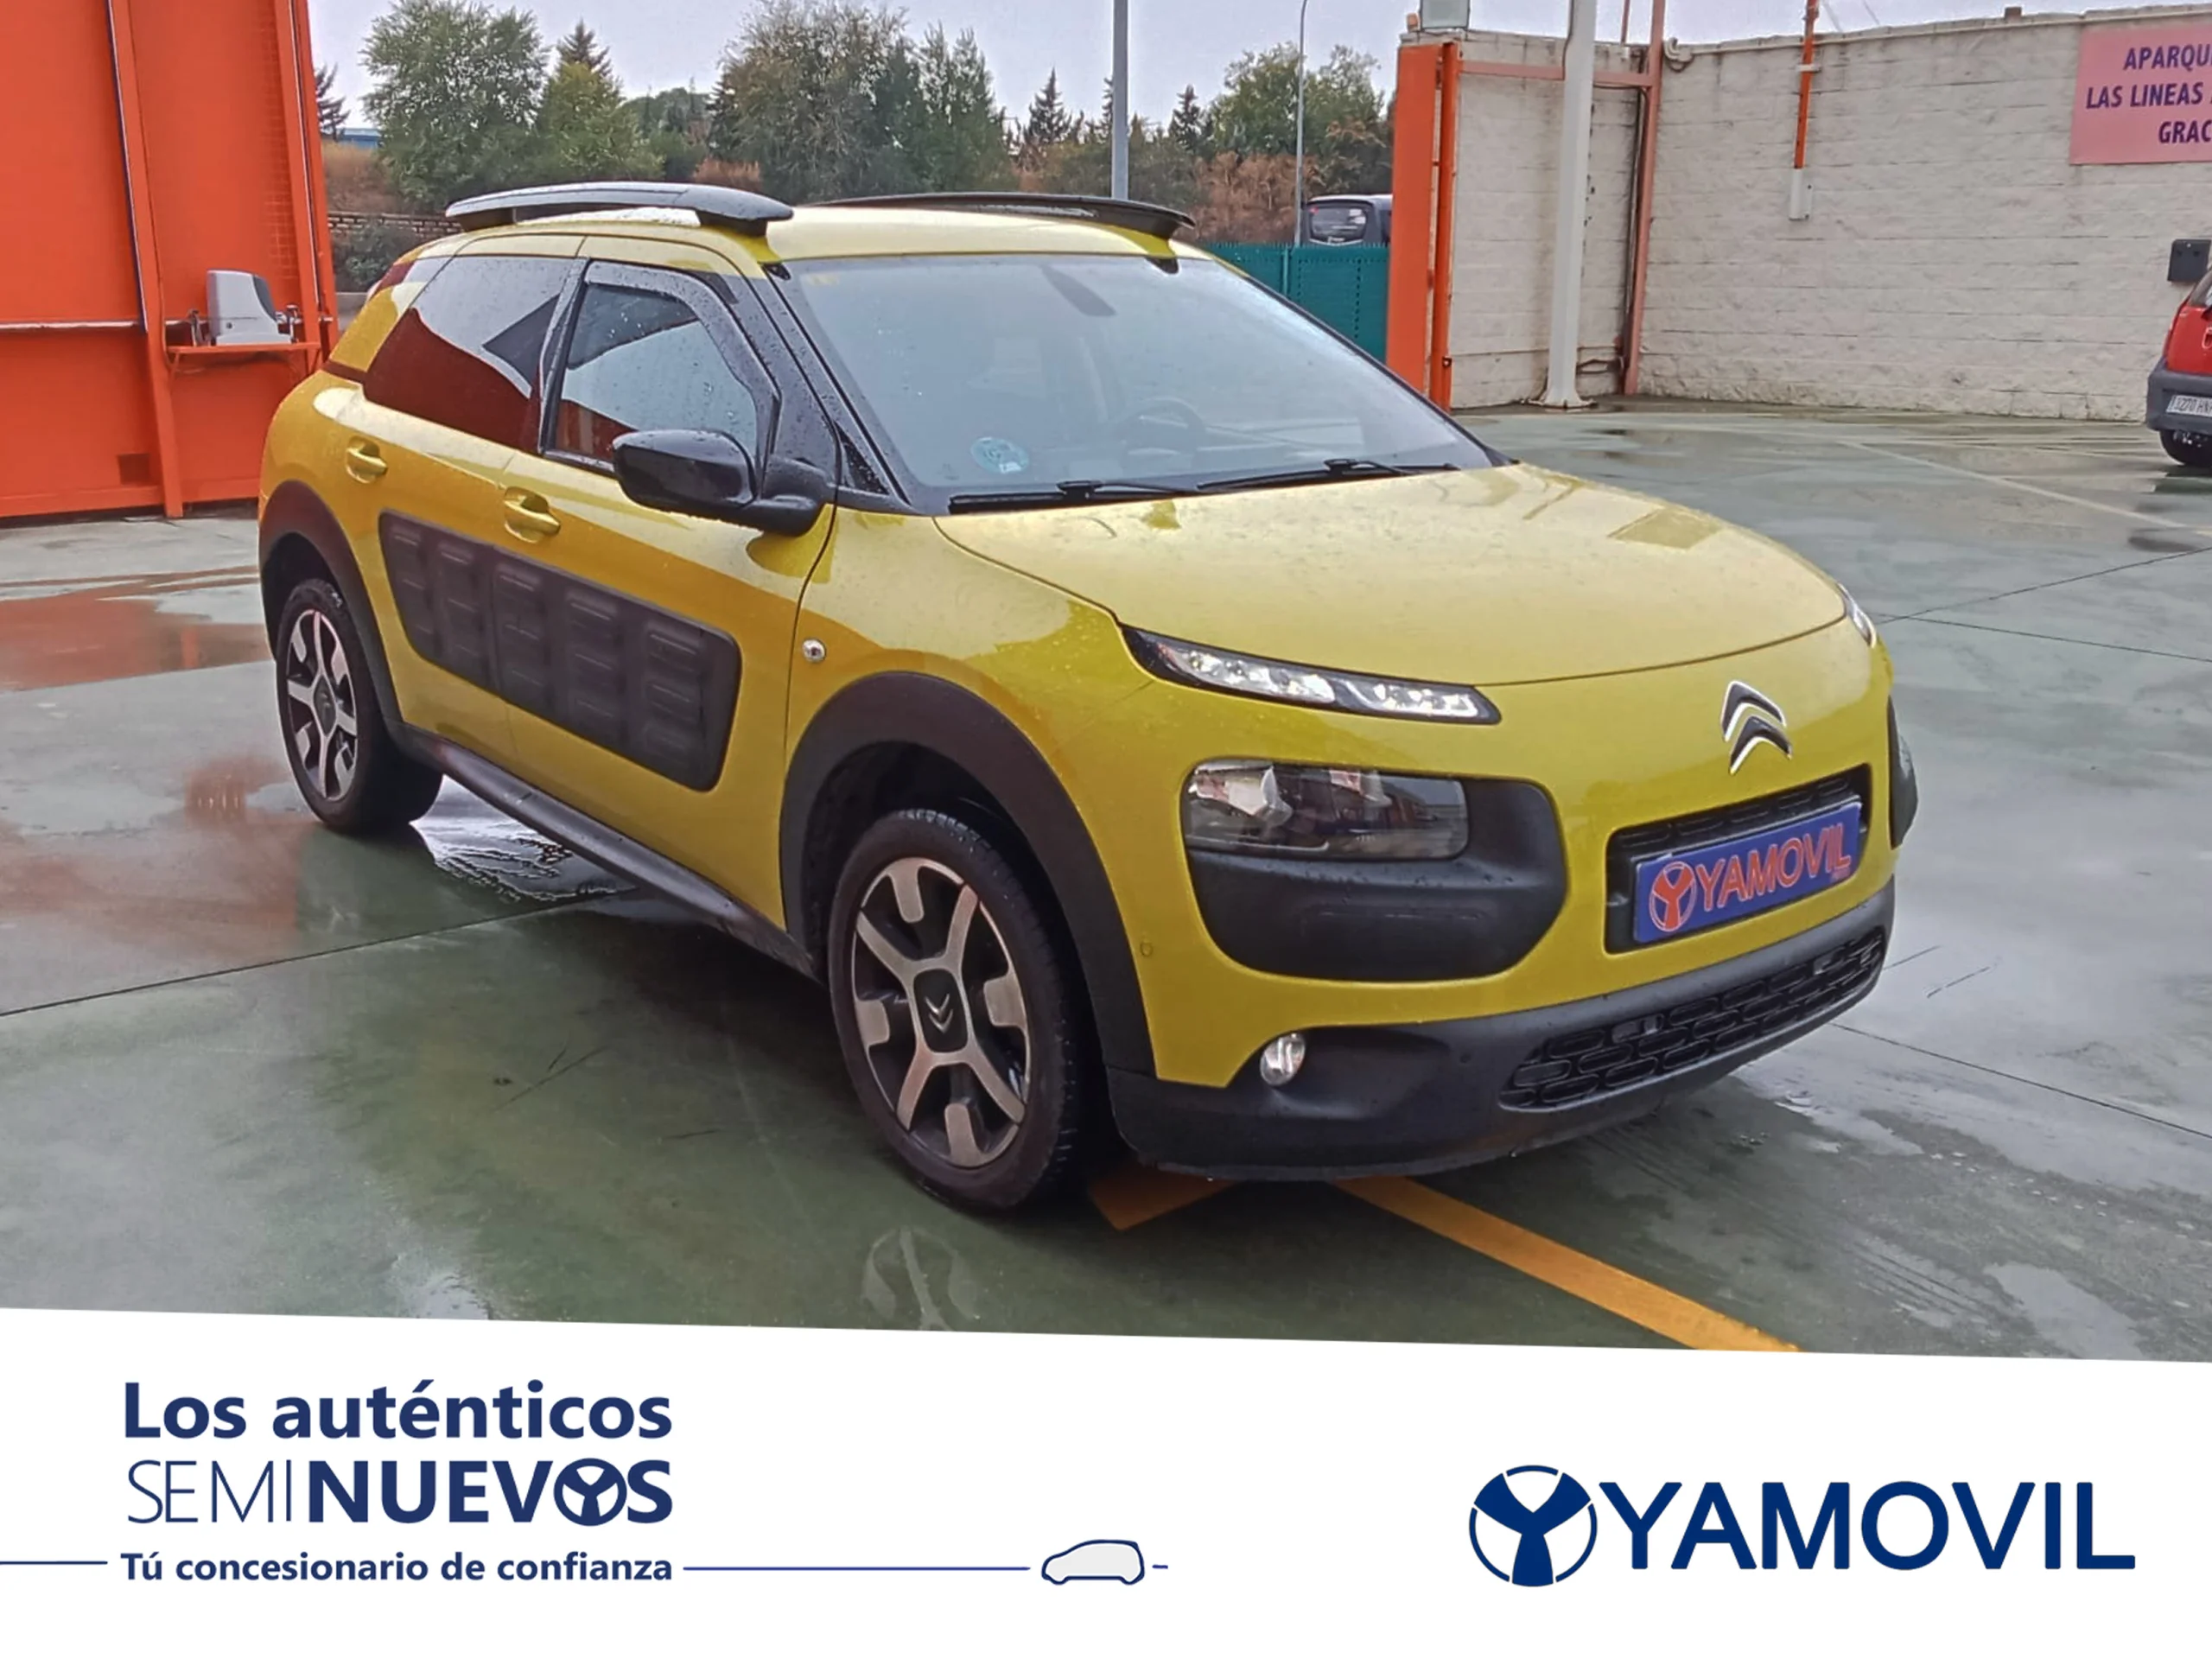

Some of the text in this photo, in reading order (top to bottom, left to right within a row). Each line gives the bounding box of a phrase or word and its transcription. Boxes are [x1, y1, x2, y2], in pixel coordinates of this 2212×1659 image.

[2122, 43, 2212, 72] APARQU
[2086, 81, 2203, 109] LAS LINEAS
[1695, 823, 1852, 912] YAMOVIL
